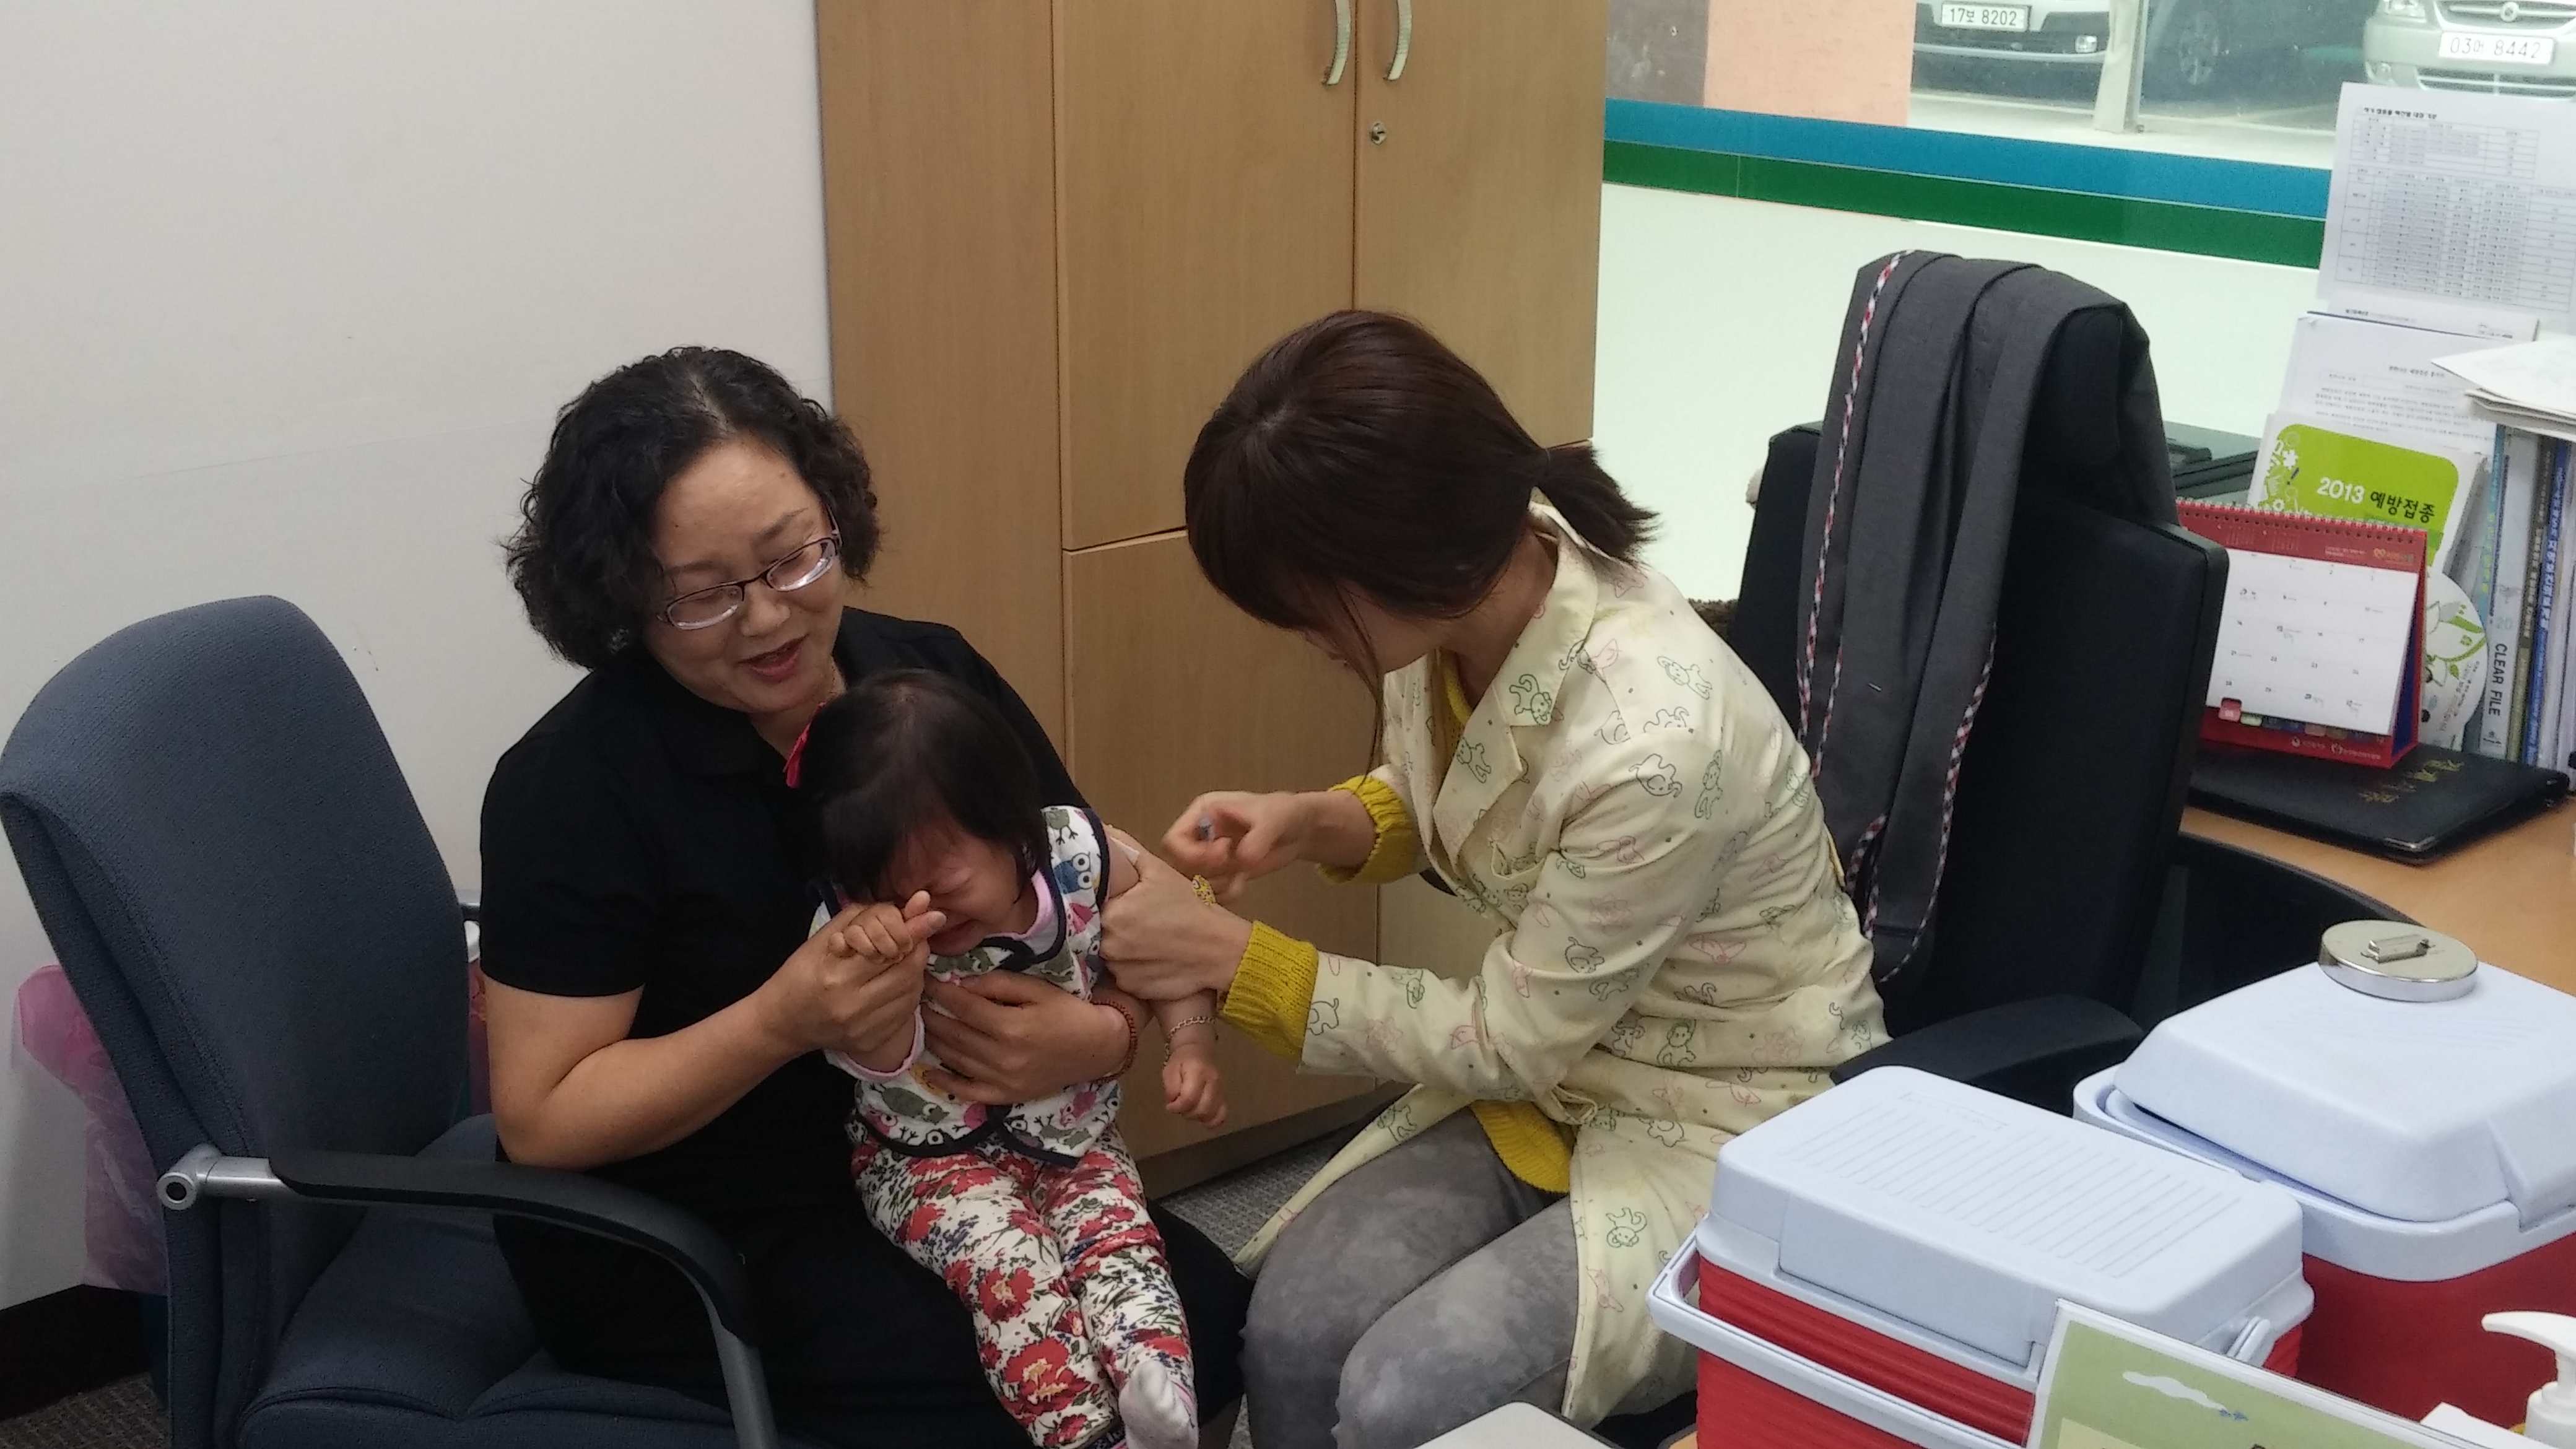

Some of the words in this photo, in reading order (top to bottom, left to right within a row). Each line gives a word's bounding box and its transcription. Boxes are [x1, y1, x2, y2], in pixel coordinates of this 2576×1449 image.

[1950, 8, 1975, 23] 17보
[1982, 9, 2017, 26] 8202
[2494, 40, 2541, 58] 8442
[2317, 476, 2365, 504] 2013
[2370, 491, 2435, 524] 예방접종
[2491, 643, 2508, 684] CLEAR
[2488, 689, 2503, 716] FILE
